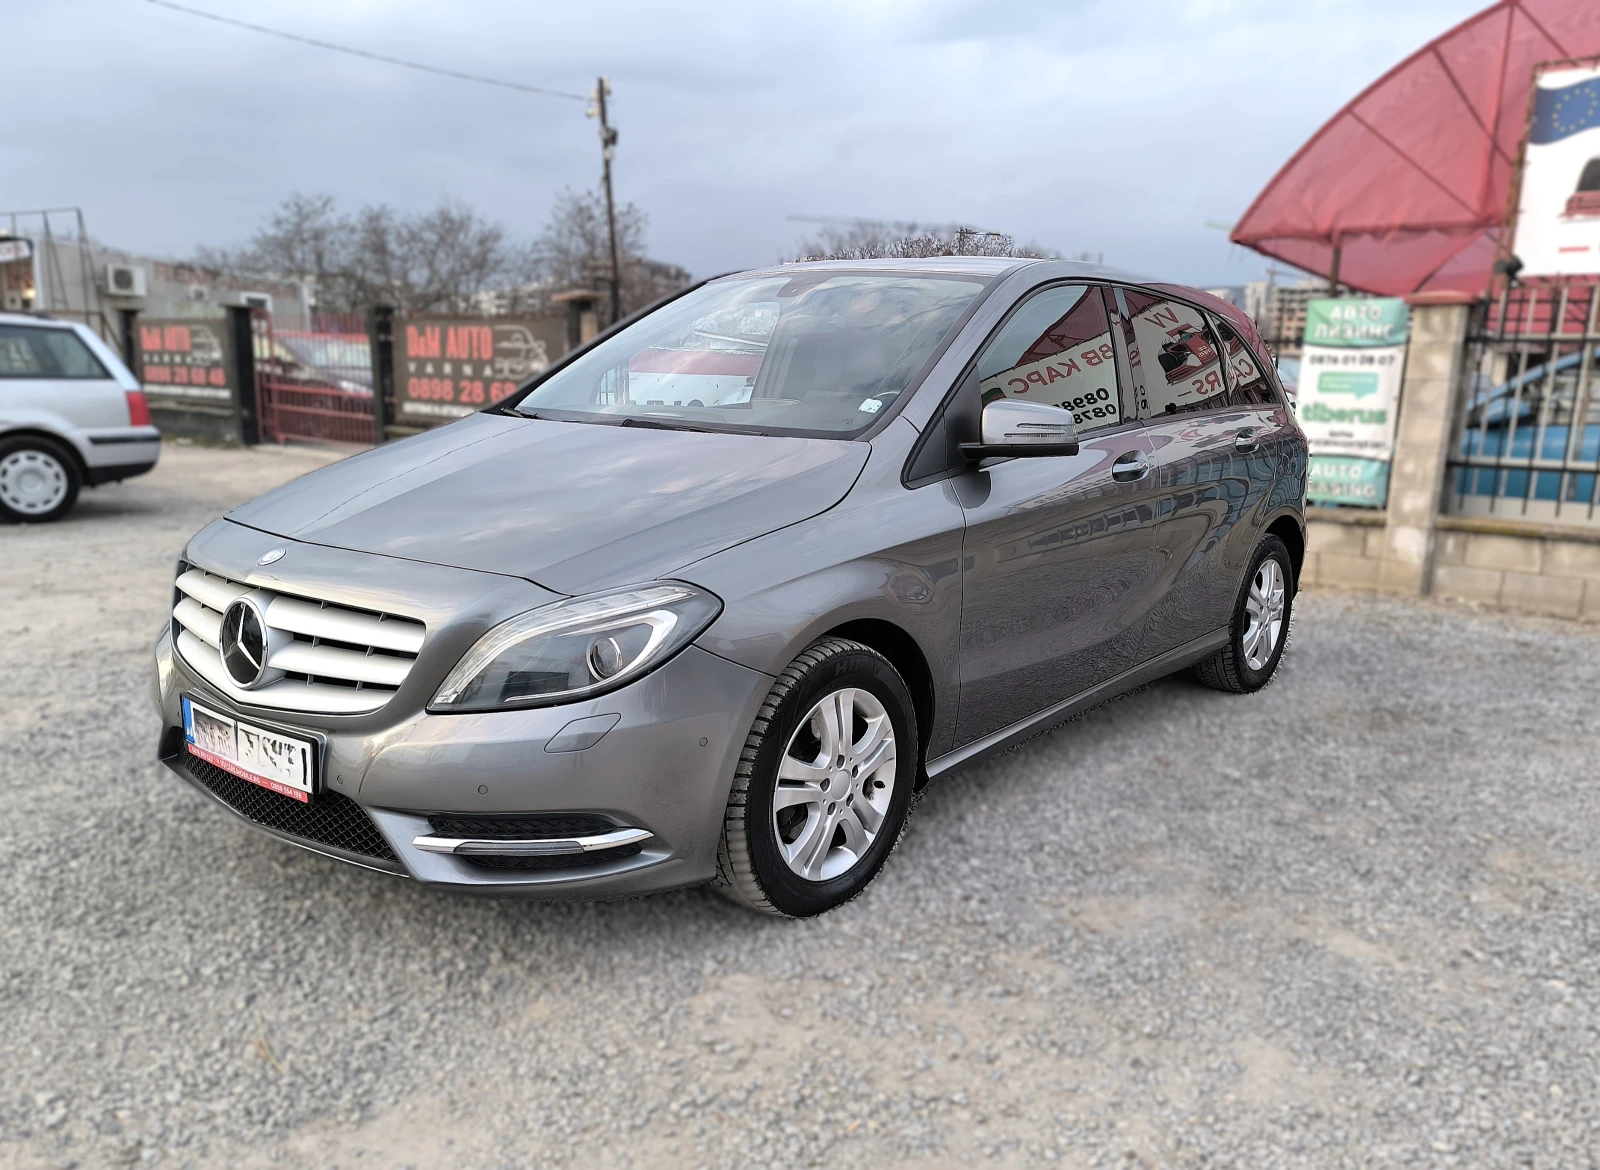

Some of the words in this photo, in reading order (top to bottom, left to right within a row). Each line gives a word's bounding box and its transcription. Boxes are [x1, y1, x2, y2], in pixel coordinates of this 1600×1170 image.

[1329, 305, 1382, 321] АВТО
[445, 325, 494, 361] AUTO
[408, 361, 494, 377] VARNA
[408, 376, 454, 401] 0898
[459, 379, 485, 404] 28
[1312, 463, 1363, 479] AUTO
[1308, 482, 1377, 499] EASING
